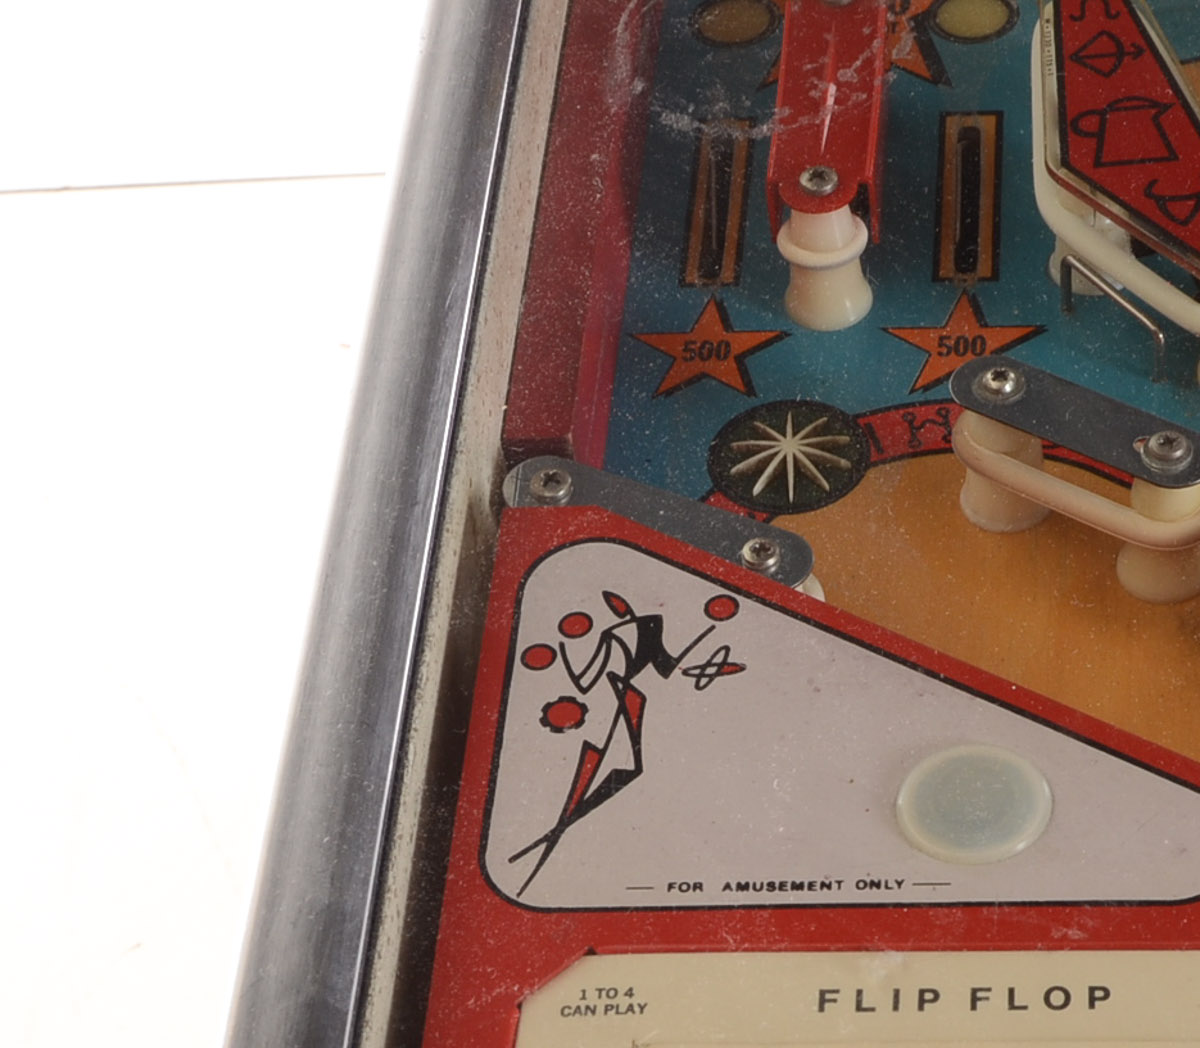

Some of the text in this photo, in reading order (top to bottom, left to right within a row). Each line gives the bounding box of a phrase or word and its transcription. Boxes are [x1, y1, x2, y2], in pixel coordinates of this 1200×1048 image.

[681, 339, 732, 362] 500
[936, 334, 987, 357] 500
[667, 878, 906, 893] FOR AMUSEMENT ONLY
[579, 987, 635, 1000] 1 TO 4
[818, 986, 1112, 1013] FLIP FLOP
[560, 1002, 648, 1018] CAN PLAY
